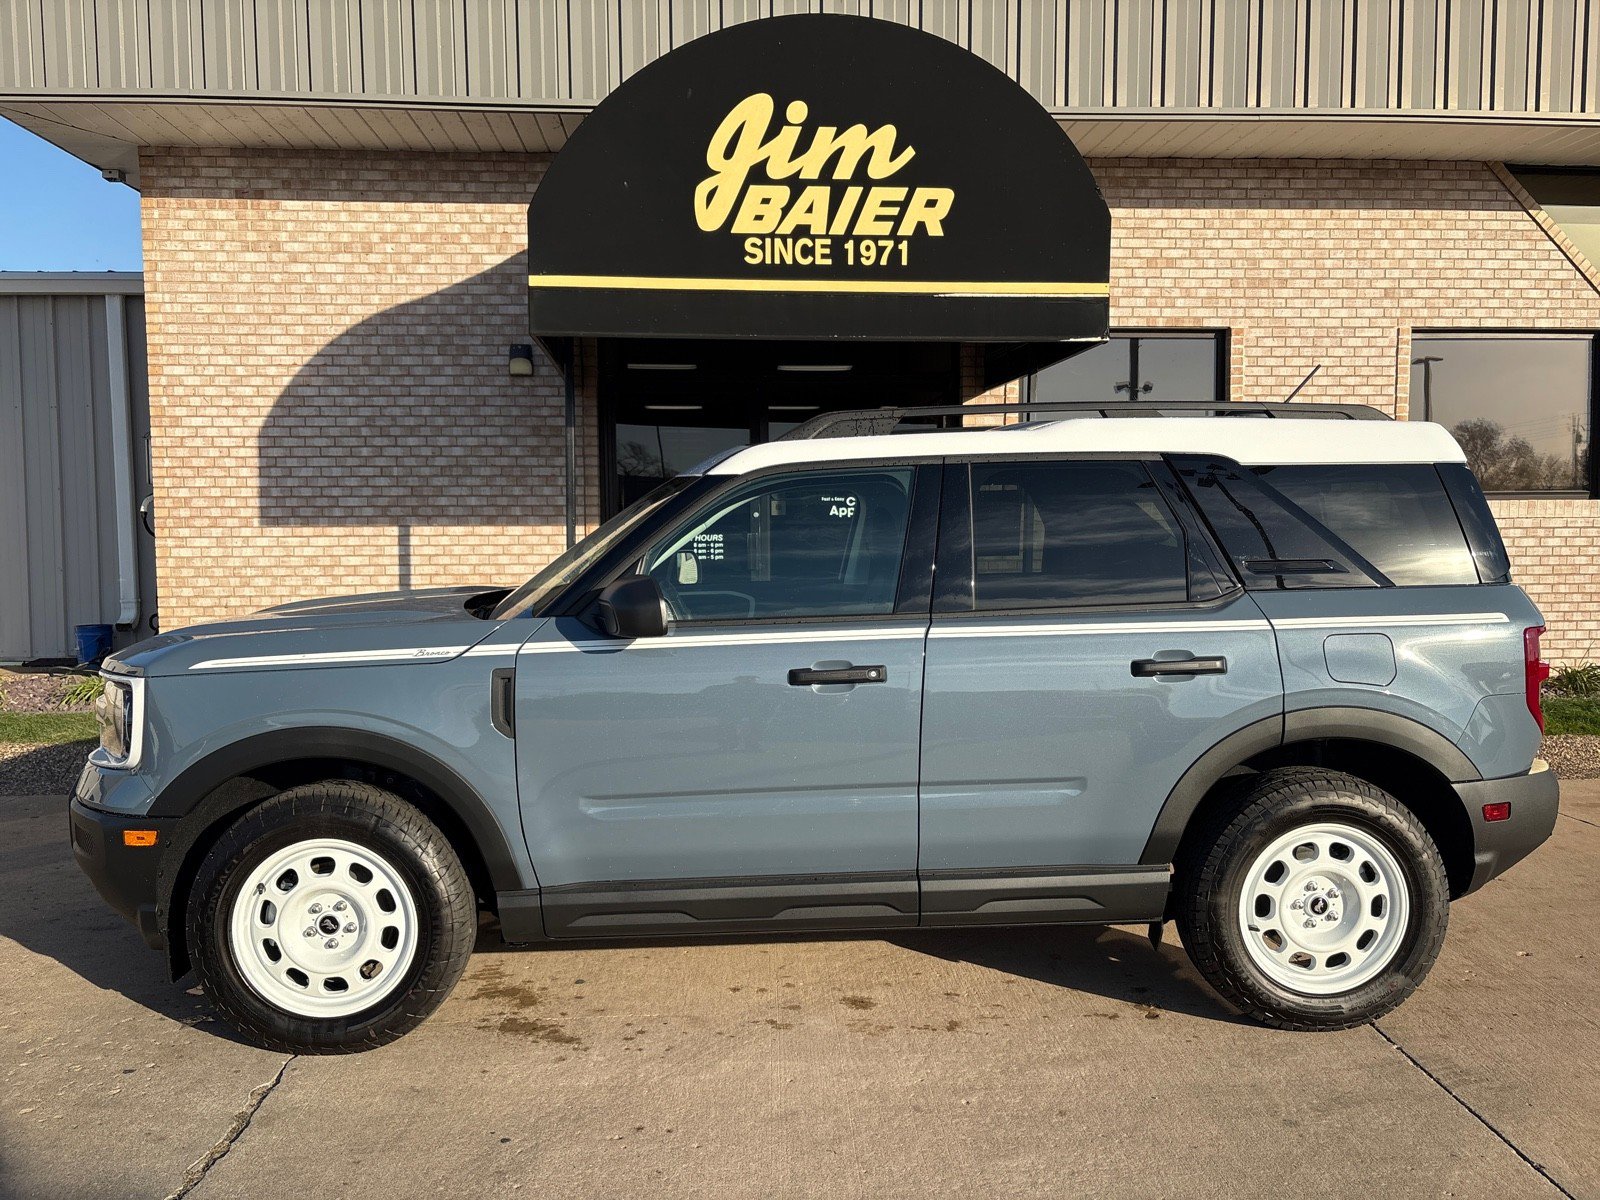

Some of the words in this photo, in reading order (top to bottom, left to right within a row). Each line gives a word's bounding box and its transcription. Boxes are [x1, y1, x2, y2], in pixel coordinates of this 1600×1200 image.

[694, 92, 916, 232] Jim
[731, 184, 955, 236] BAIER
[744, 237, 832, 265] SINCE
[844, 239, 908, 266] 1971
[413, 649, 451, 657] Bronco
